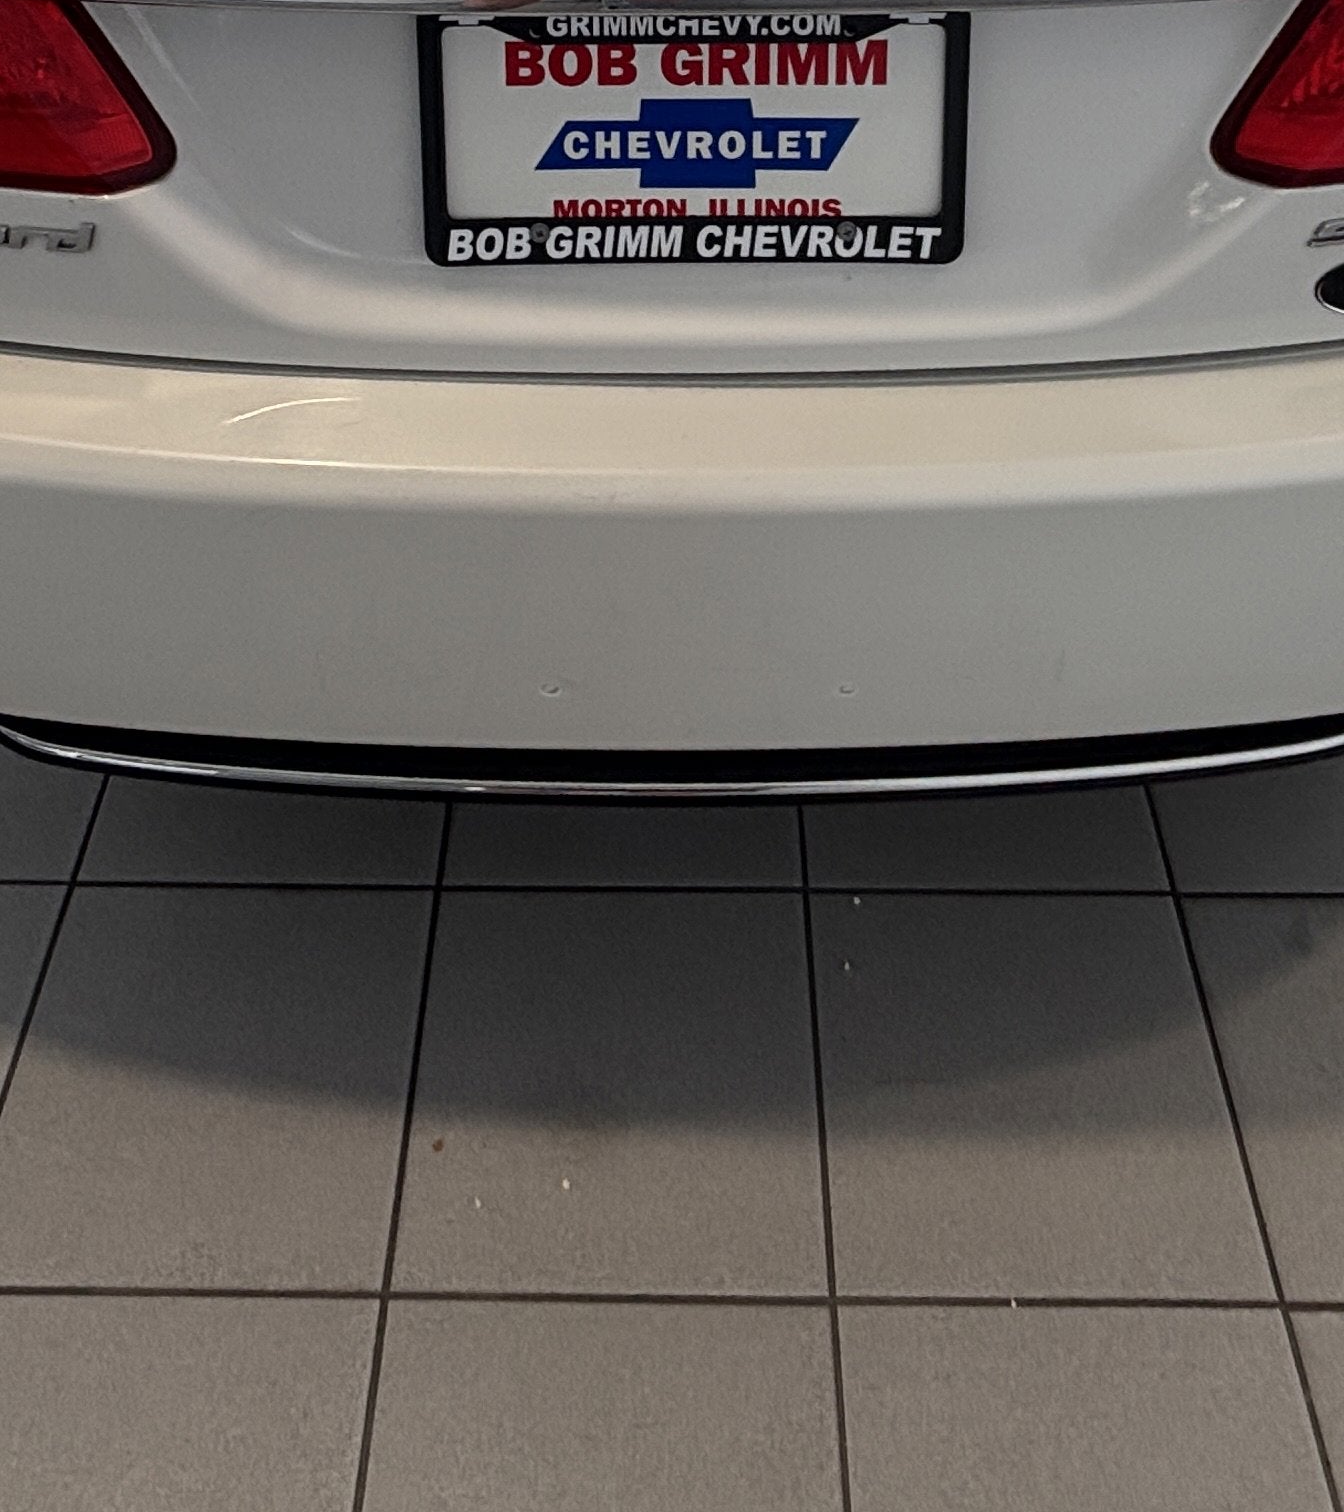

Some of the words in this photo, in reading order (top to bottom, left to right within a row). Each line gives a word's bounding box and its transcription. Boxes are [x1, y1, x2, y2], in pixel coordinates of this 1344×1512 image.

[546, 15, 842, 37] GRIMMCHEVY.COM
[504, 42, 637, 87] BOB
[660, 40, 889, 86] GRIMM
[563, 130, 827, 160] CHEVROLET
[553, 199, 688, 219] MORTON
[447, 227, 532, 261] BOB
[545, 225, 684, 260] GRIMM
[696, 224, 943, 260] CHEVROLET
